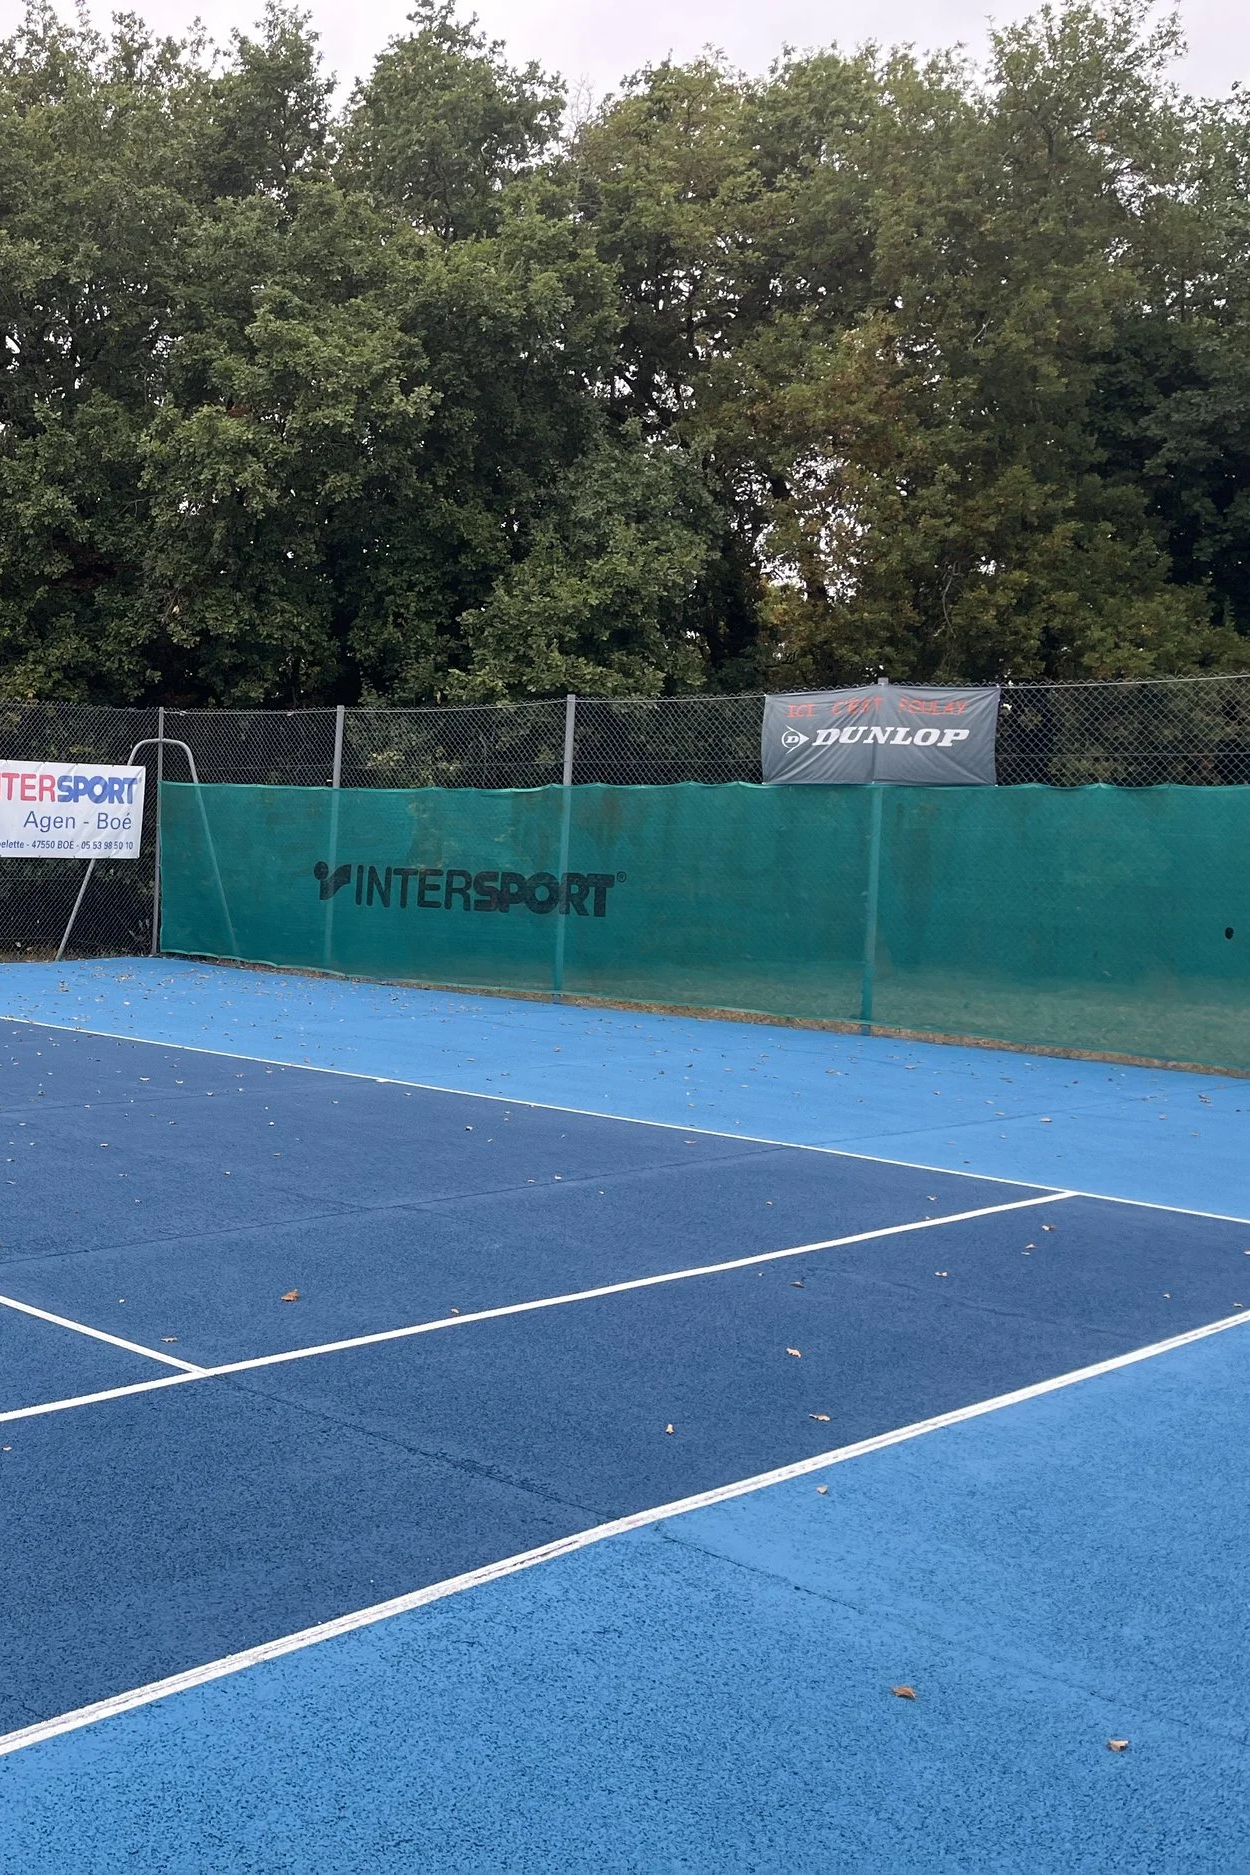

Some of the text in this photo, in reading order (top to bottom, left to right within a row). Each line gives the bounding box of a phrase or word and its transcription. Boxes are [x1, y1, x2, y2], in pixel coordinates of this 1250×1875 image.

[811, 726, 970, 747] DUNLOP
[23, 810, 76, 833] Agen
[97, 812, 132, 831] Boé
[31, 840, 56, 849] 47550
[81, 841, 91, 850] 05
[92, 841, 102, 850] 53
[114, 841, 124, 850] 50
[125, 841, 134, 850] 10
